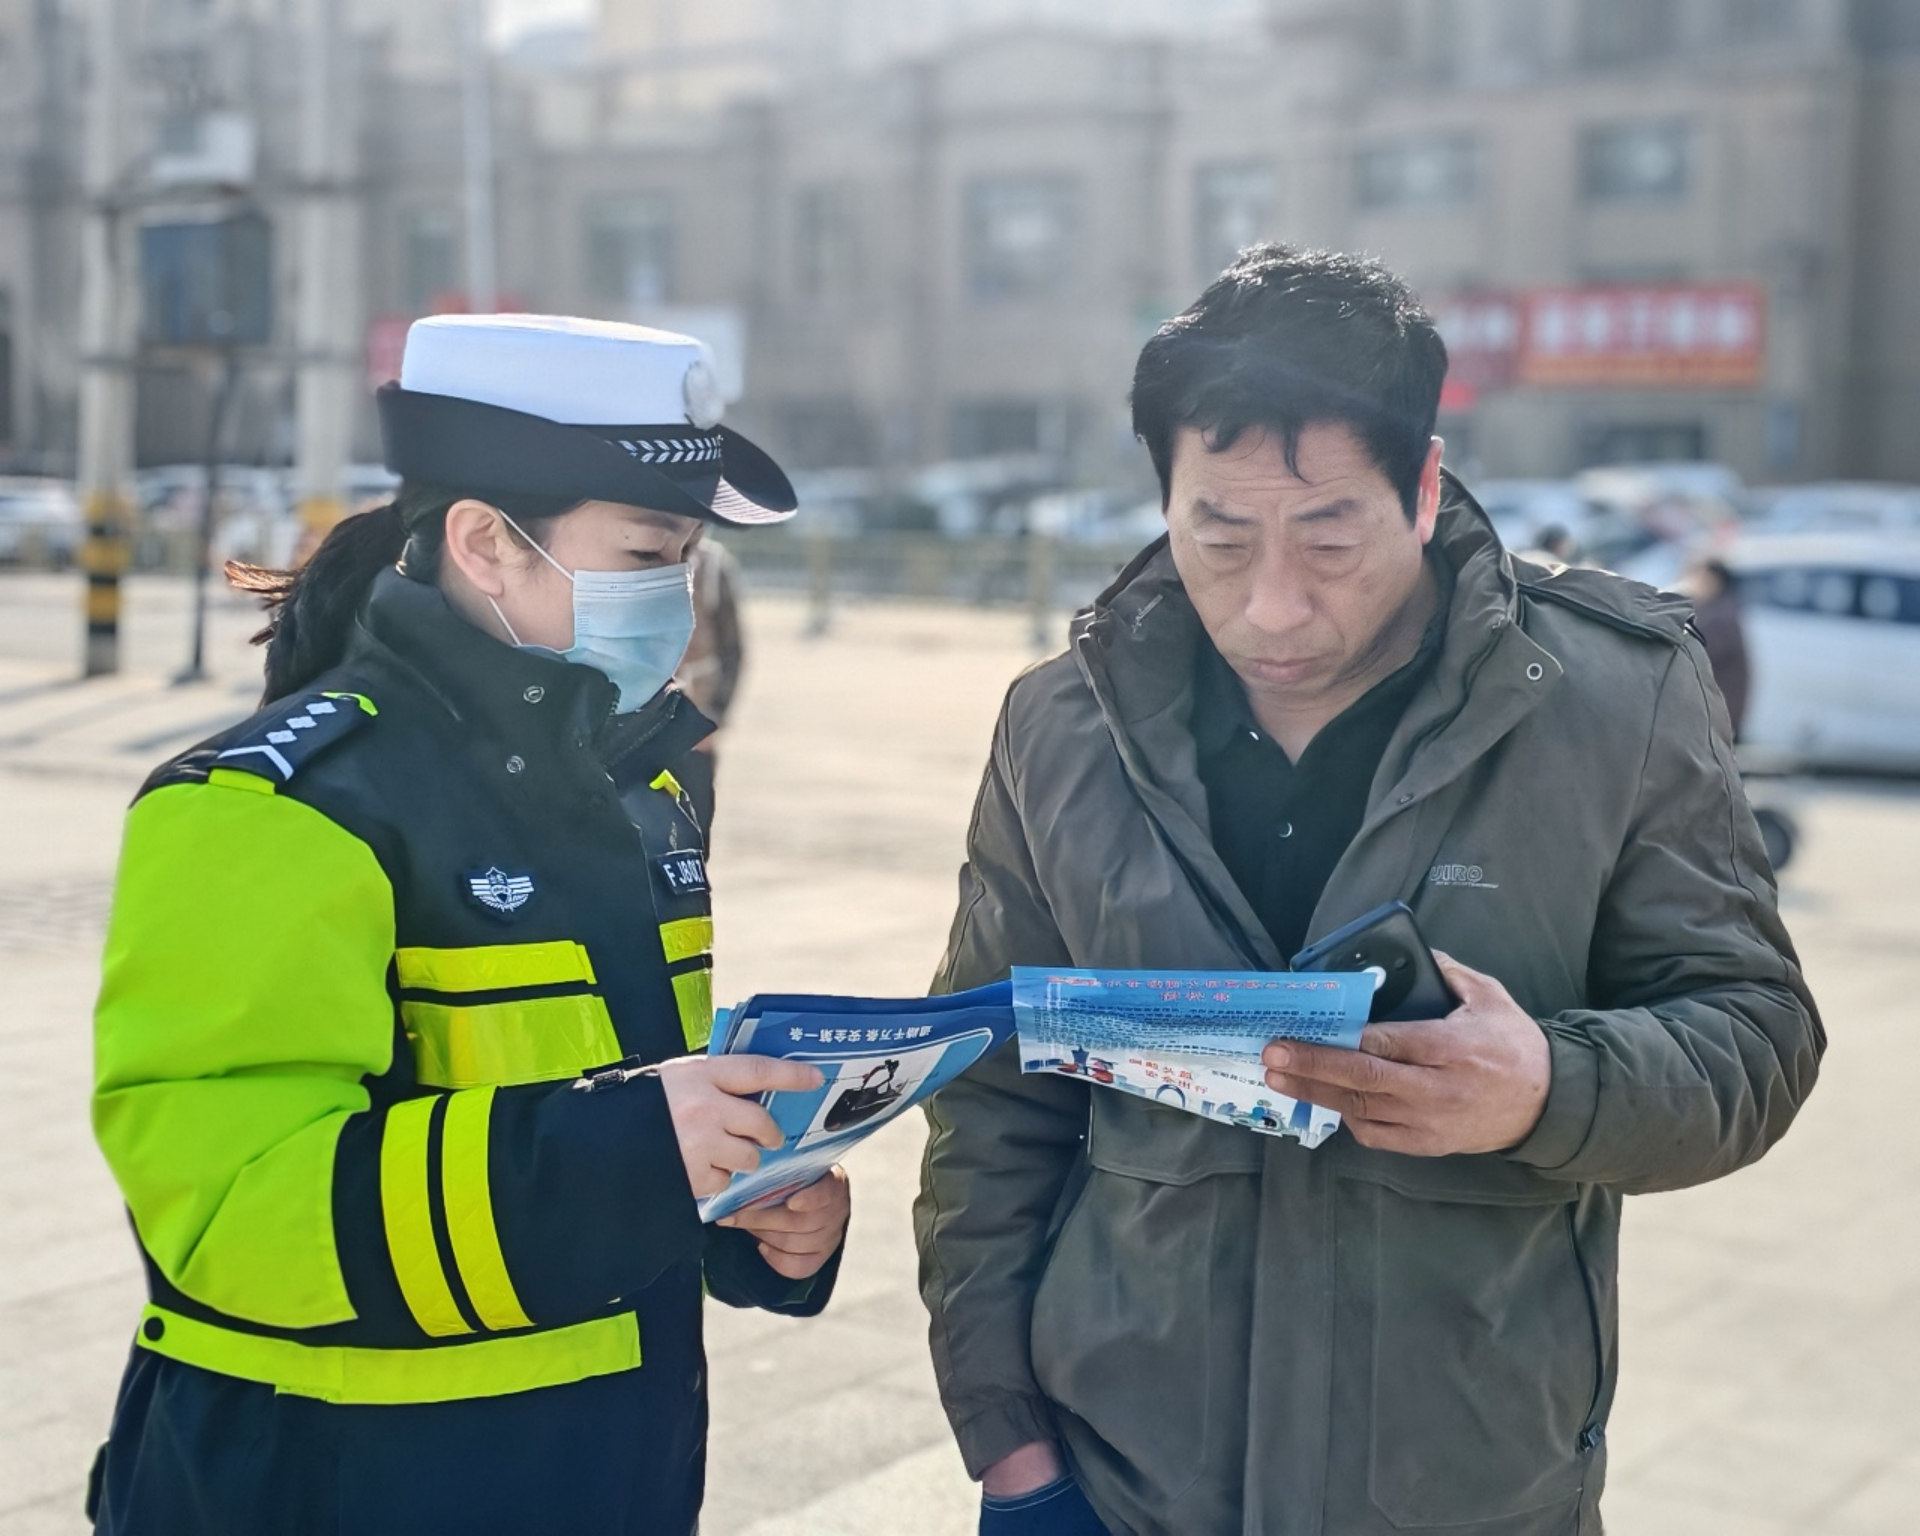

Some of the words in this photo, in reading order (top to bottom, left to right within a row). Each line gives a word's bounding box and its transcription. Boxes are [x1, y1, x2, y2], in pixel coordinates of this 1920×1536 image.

[788, 1026, 862, 1044] 安全第一条
[866, 1025, 933, 1042] 道路千万条
